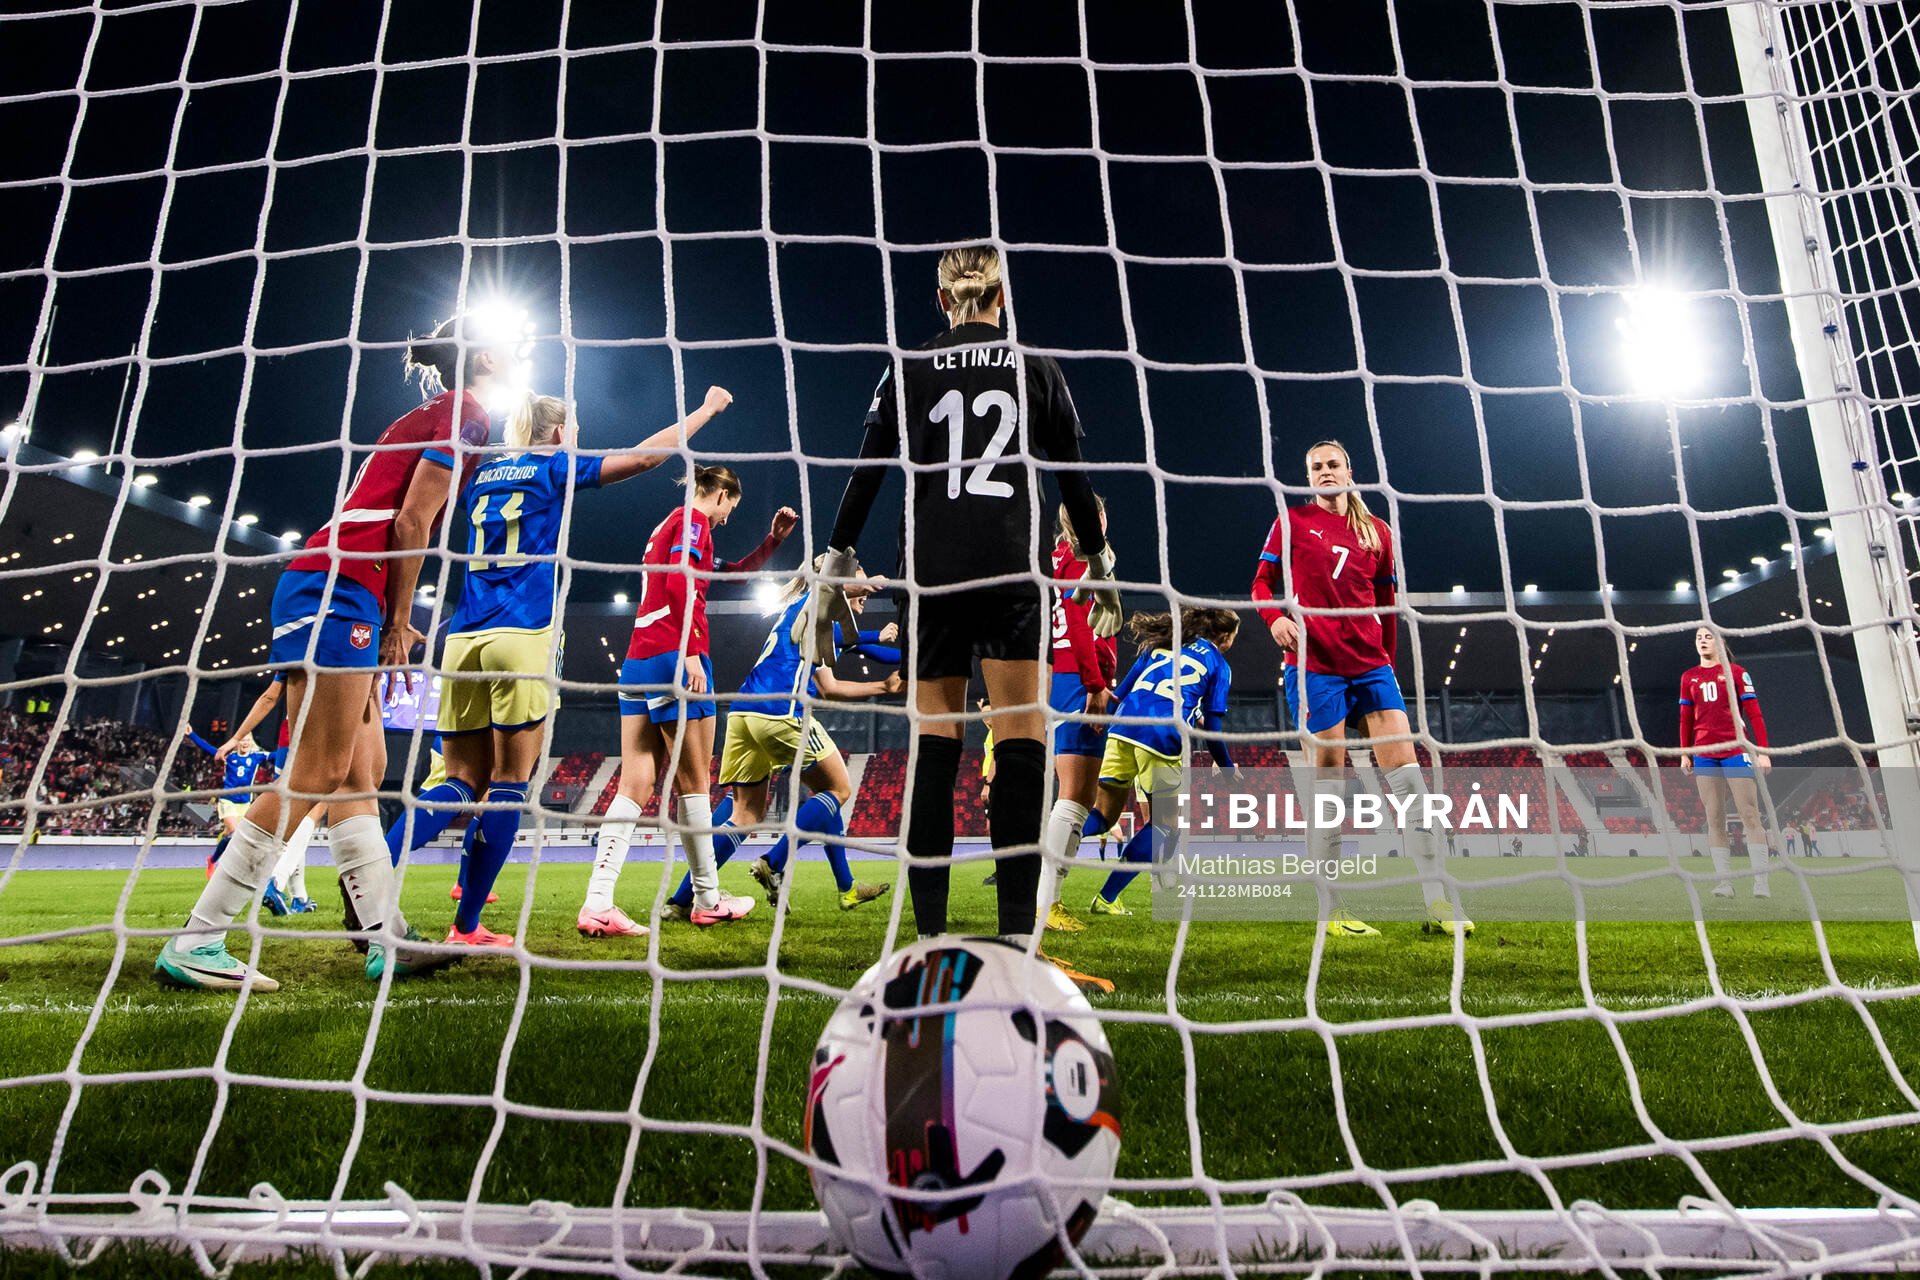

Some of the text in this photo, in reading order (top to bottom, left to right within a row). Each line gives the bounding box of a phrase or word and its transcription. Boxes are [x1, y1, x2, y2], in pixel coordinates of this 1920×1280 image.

[928, 389, 1018, 500] 12
[469, 492, 524, 572] 11
[1332, 545, 1350, 580] 7
[1131, 648, 1208, 706] 22
[1699, 681, 1718, 703] 10
[237, 765, 246, 777] 8
